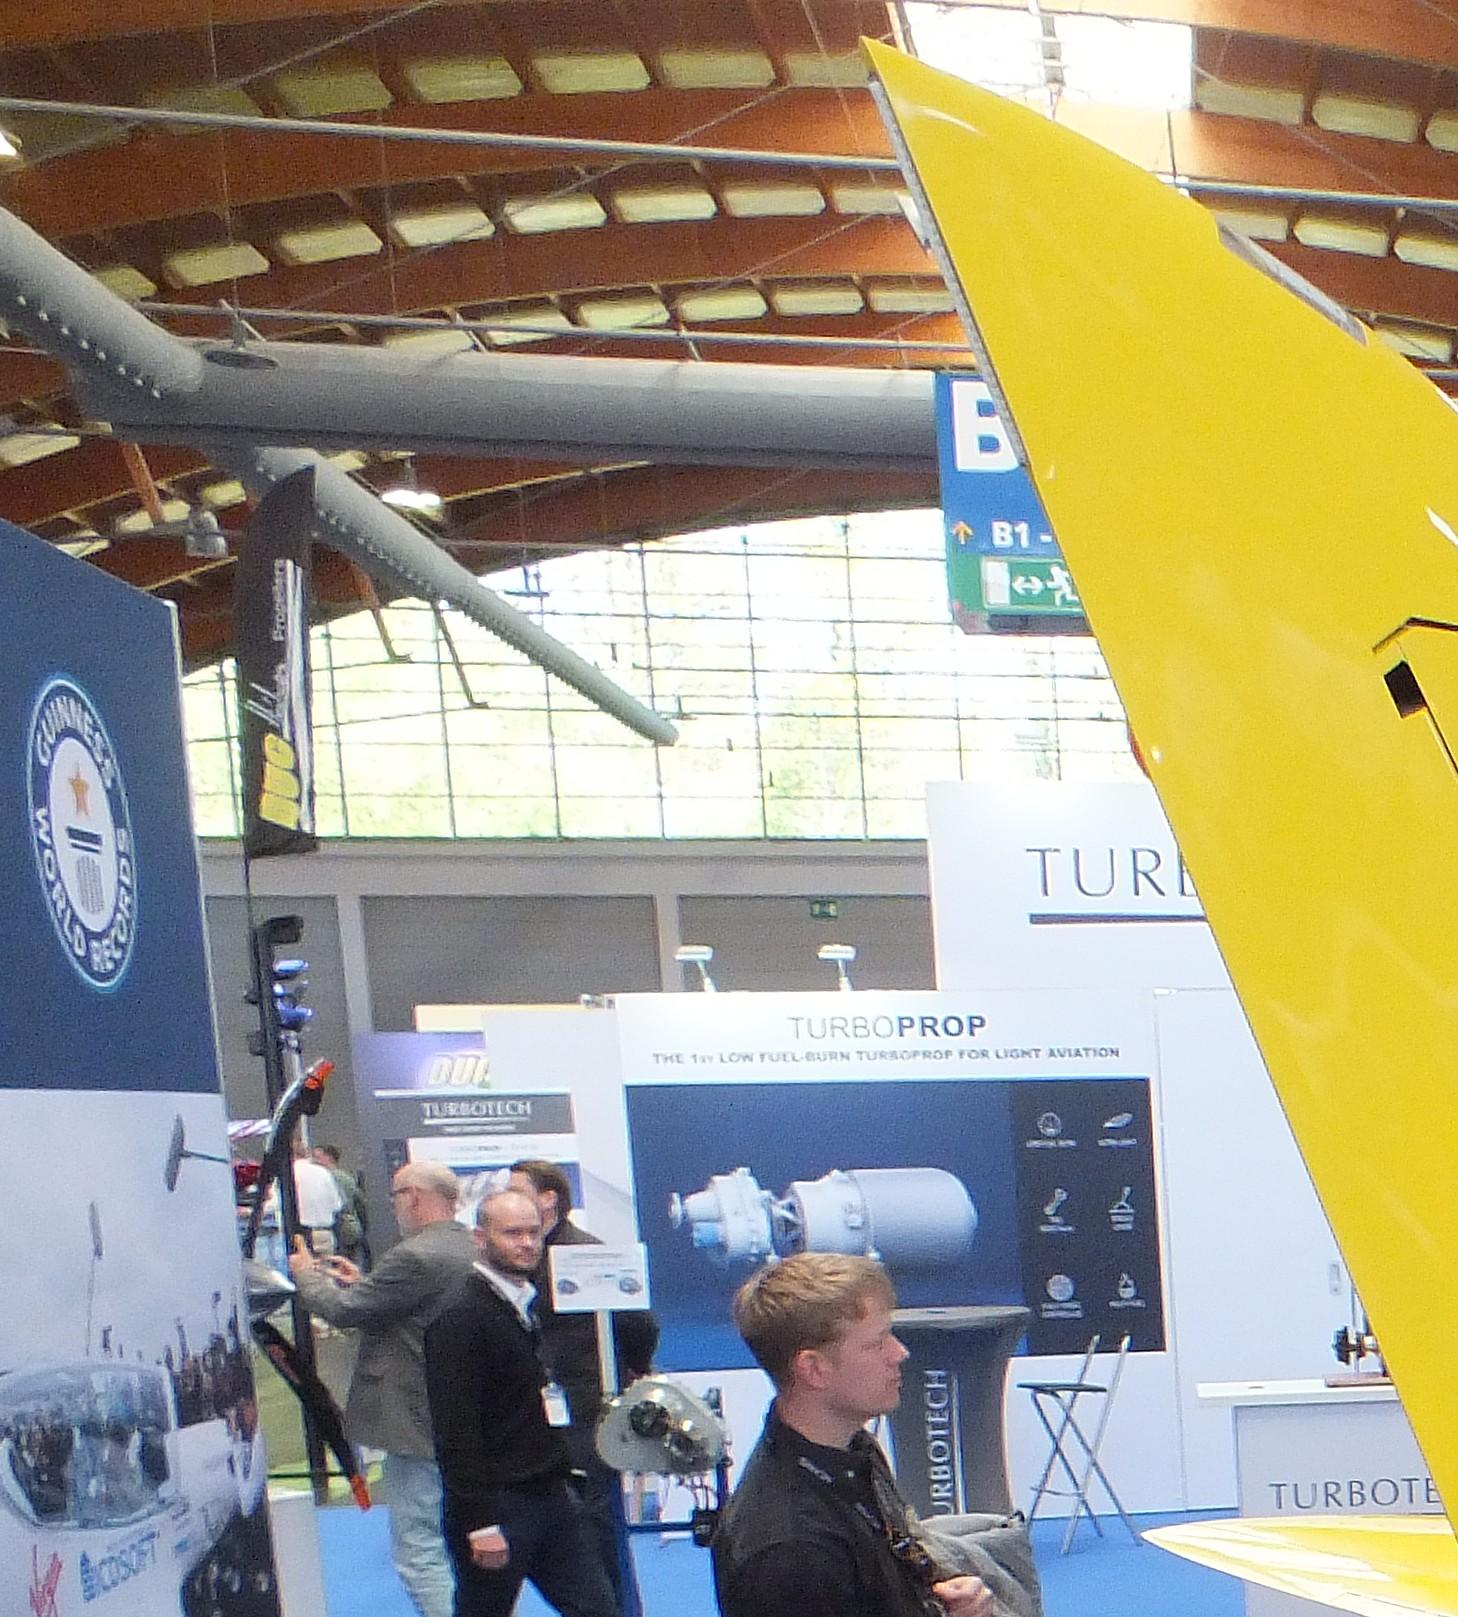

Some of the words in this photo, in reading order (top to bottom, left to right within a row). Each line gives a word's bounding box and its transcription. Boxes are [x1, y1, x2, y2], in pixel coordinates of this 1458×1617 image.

[951, 381, 1018, 471] B
[992, 521, 1031, 547] B1
[786, 1015, 987, 1039] TURBOPROP
[653, 1053, 684, 1064] THE
[719, 1051, 753, 1063] LOW
[759, 1050, 850, 1063] FUEL-BURN
[856, 1050, 953, 1062] TURBOPROP
[959, 1050, 990, 1061] FOR
[995, 1048, 1041, 1060] LIGHT
[1048, 1047, 1120, 1059] AVIATION
[422, 1101, 531, 1117] TURBOTECH
[924, 1370, 955, 1514] URBOTECH
[1269, 1478, 1440, 1509] TURBOTE
